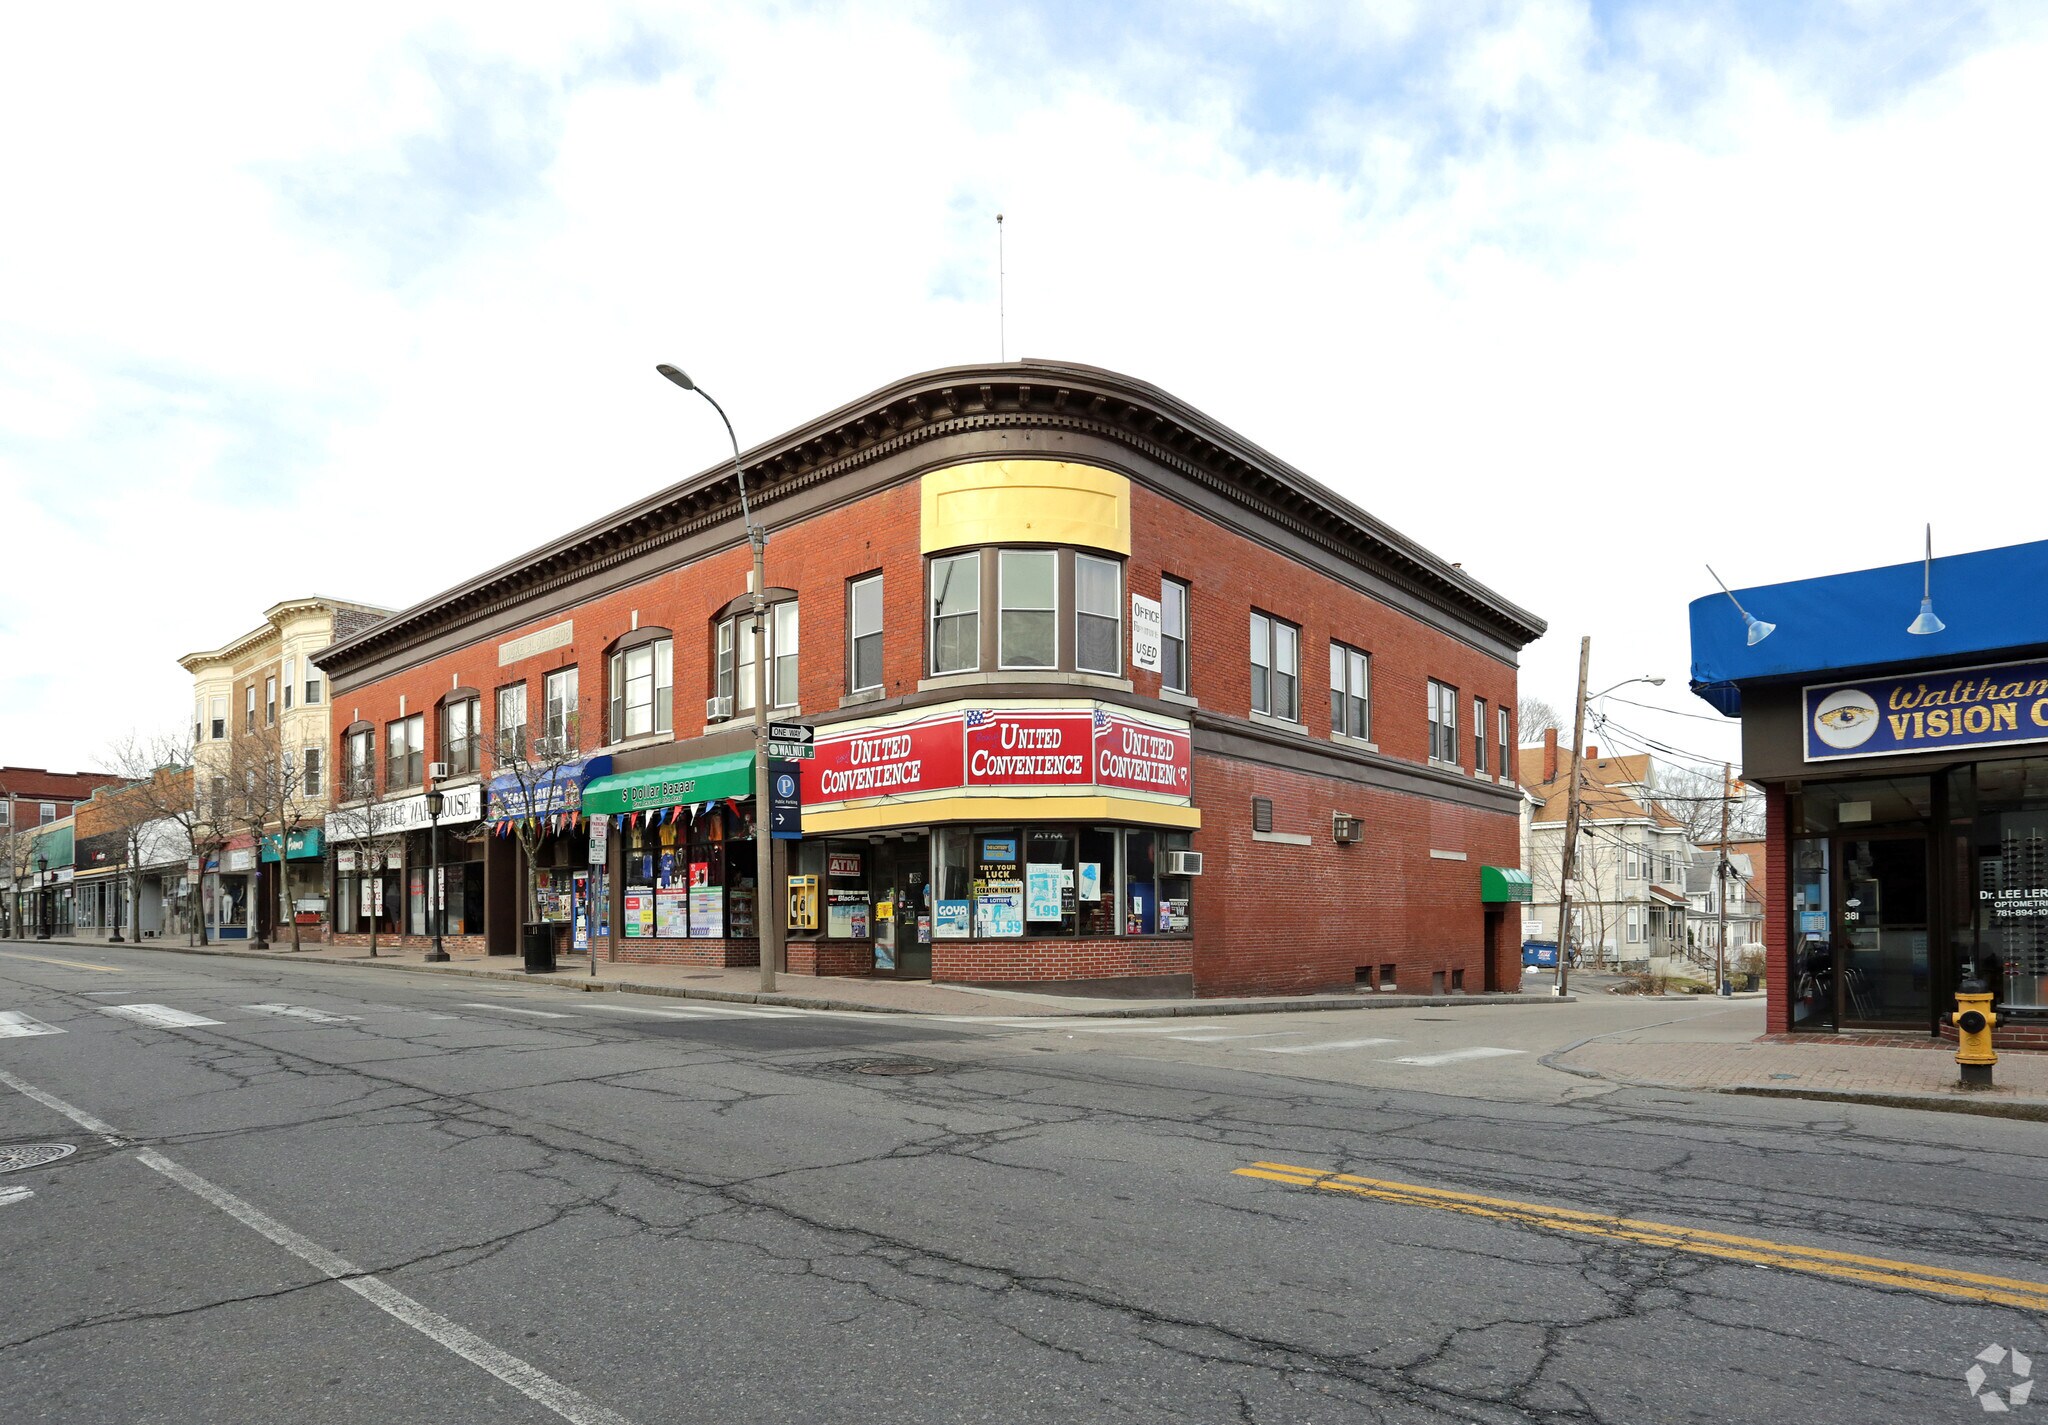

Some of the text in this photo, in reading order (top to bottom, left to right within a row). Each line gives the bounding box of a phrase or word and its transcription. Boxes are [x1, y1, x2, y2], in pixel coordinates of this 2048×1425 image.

[1136, 642, 1158, 658] USED
[1887, 703, 2019, 741] VISION
[773, 727, 801, 738] ONE WAY
[1000, 723, 1062, 749] UNITED
[778, 744, 805, 757] WALNUT
[850, 734, 912, 766] UNITED
[1122, 727, 1174, 762] UNITED
[971, 749, 1083, 776] CONVENIENCE
[821, 760, 921, 795] CONVENIENCE
[632, 784, 660, 801] Dollar
[662, 780, 695, 797] Bazaar
[781, 779, 792, 794] P
[830, 859, 858, 871] ATM
[986, 871, 1010, 879] LUCK
[977, 885, 1020, 894] SCRATCH TICKETS
[1979, 890, 1995, 900] Dr.
[1998, 889, 2021, 899] LEE
[939, 905, 967, 916] GOYA
[1034, 905, 1059, 917] 1.99
[1844, 911, 1859, 921] 381
[994, 920, 1022, 933] 1.99
